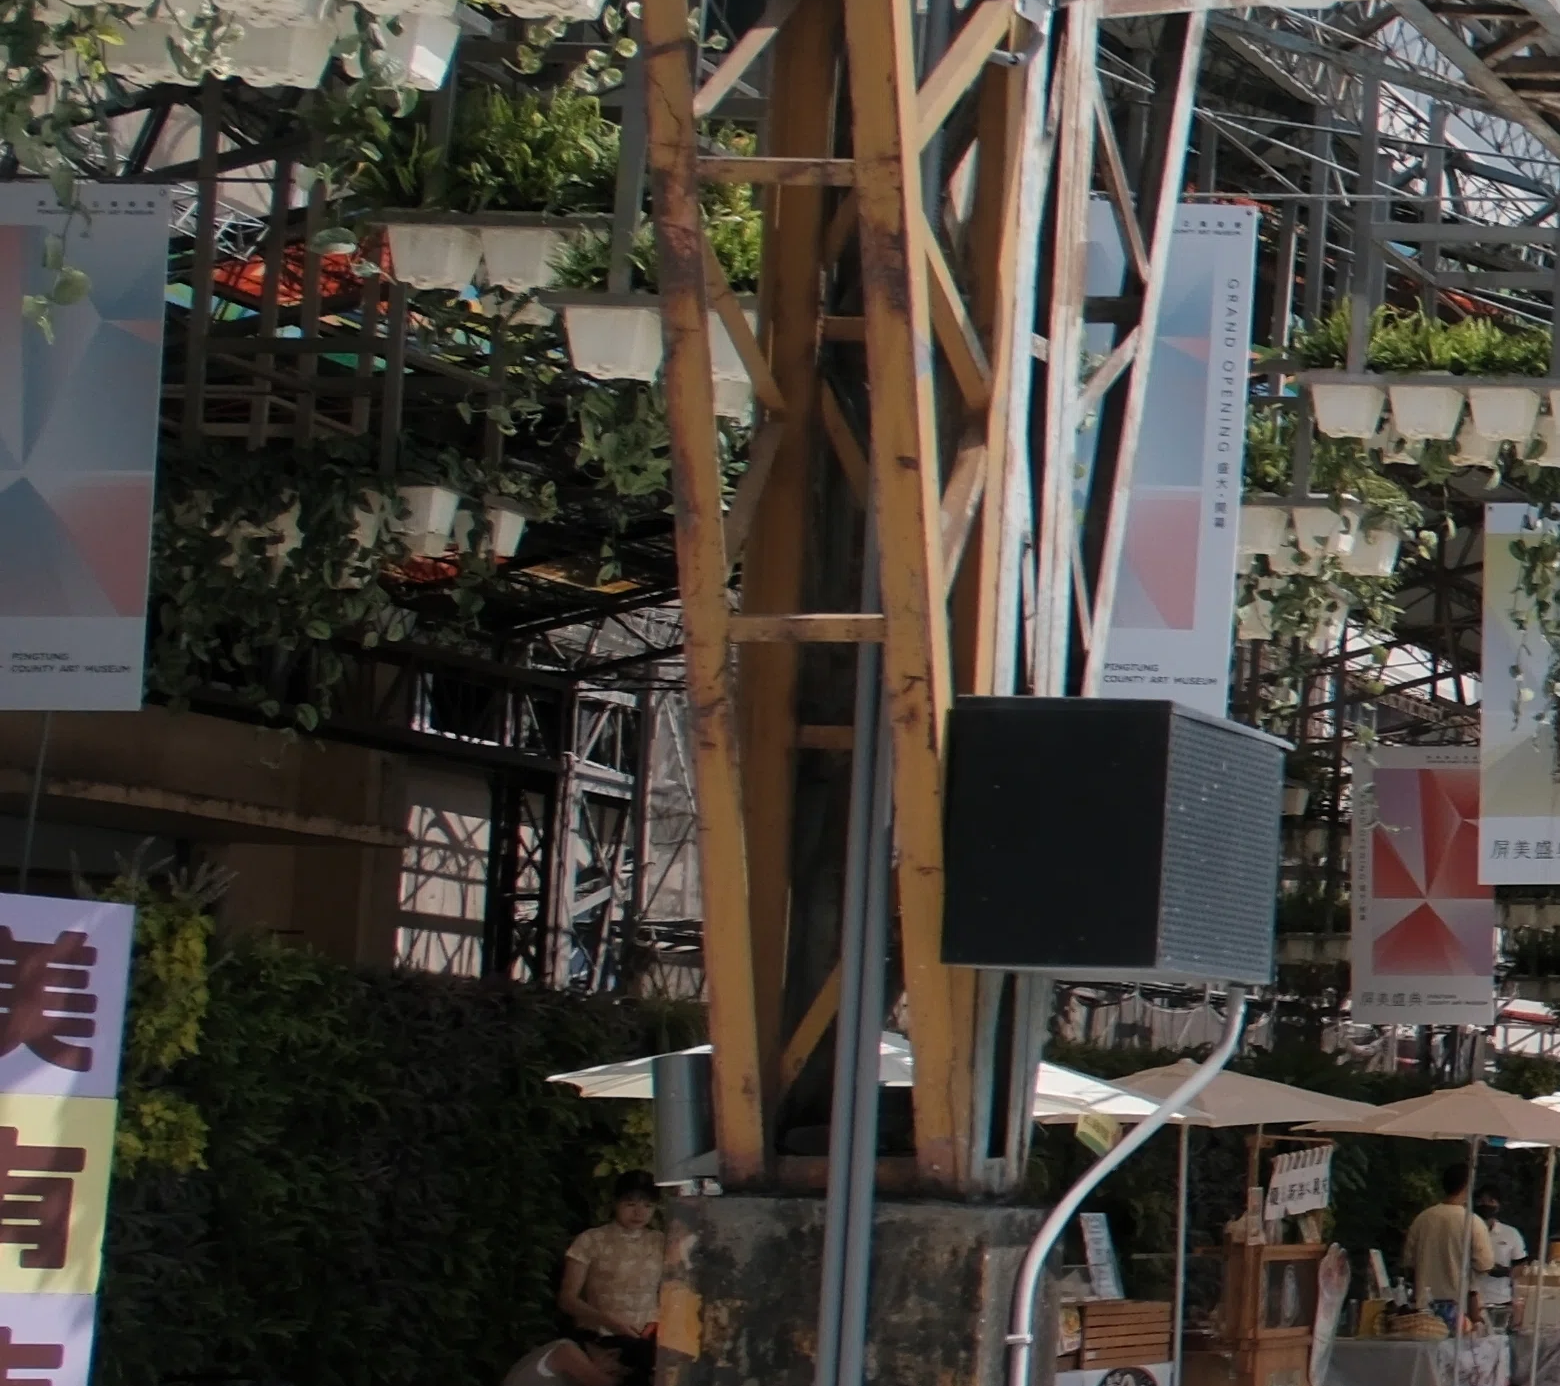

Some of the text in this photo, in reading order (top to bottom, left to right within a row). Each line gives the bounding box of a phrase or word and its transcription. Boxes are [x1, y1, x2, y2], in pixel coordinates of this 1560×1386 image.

[1225, 277, 1240, 348] GRAND
[1217, 360, 1236, 453] OPENING
[12, 652, 69, 661] PINGTUNG
[1104, 663, 1159, 672] PINGTUNG
[1103, 675, 1218, 685] COUNTY ART MUSEUM
